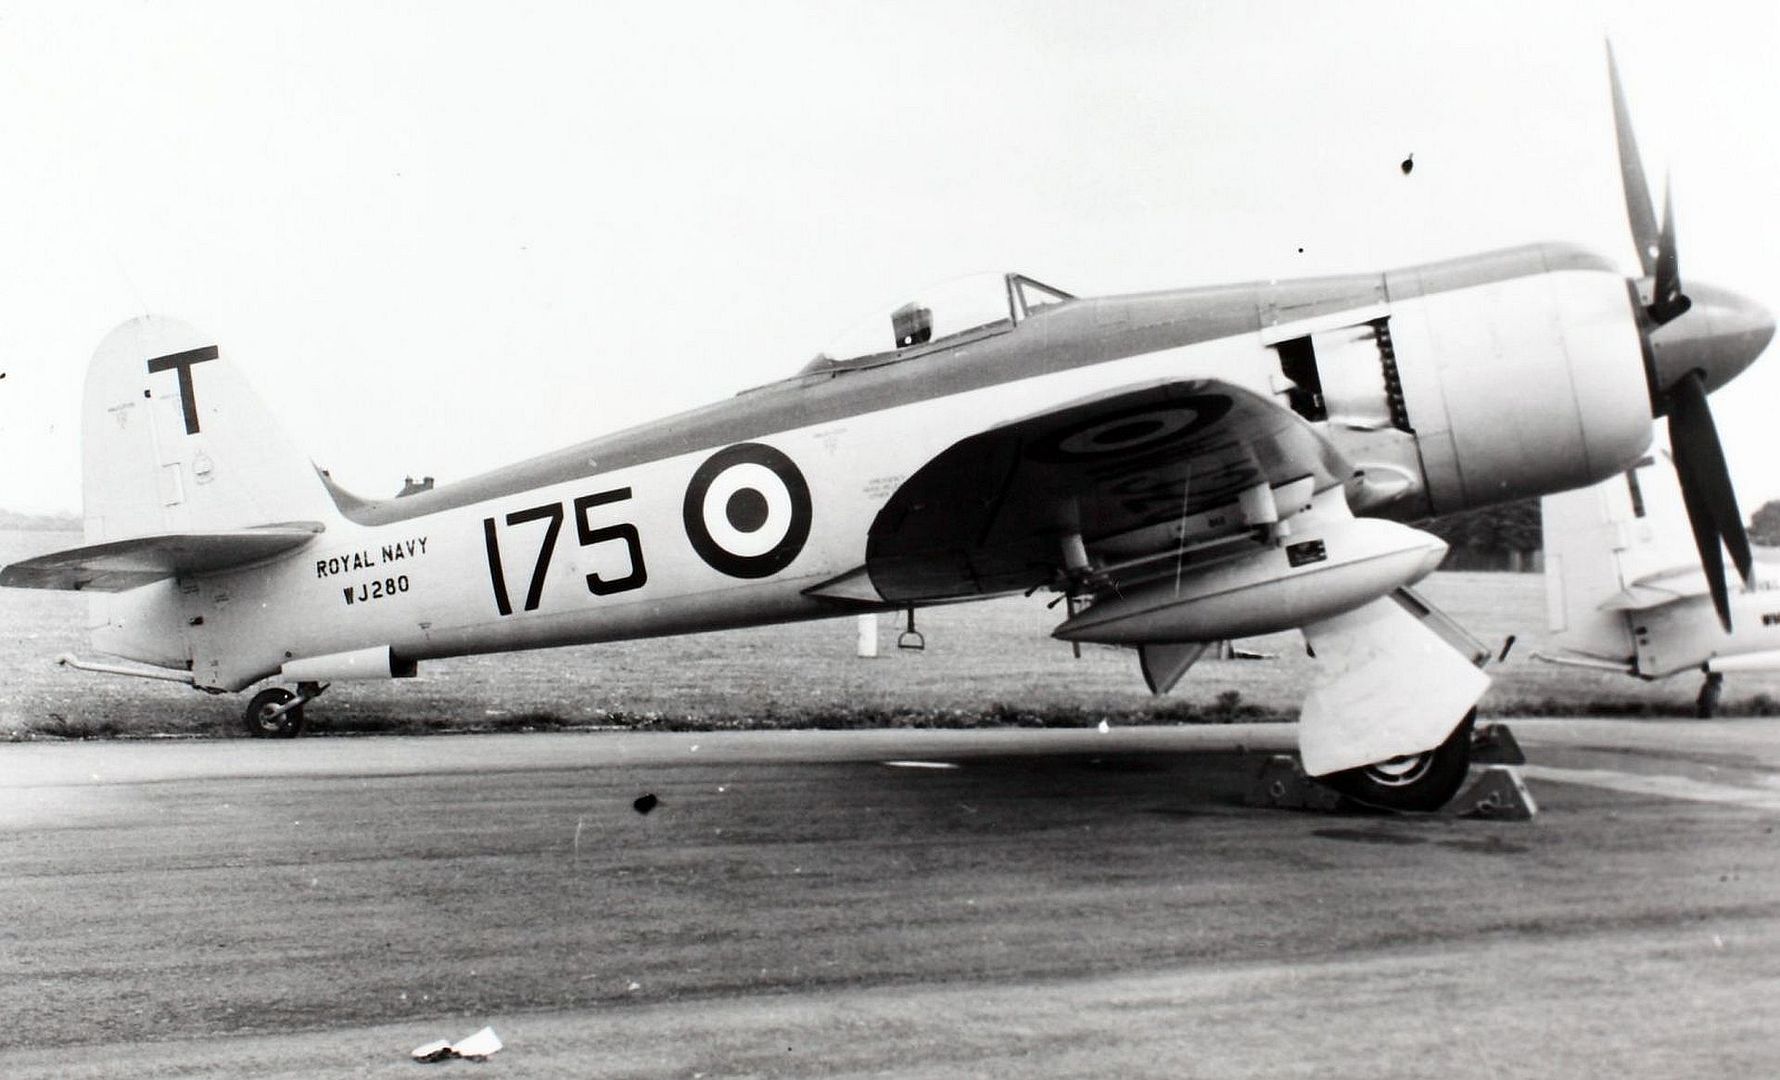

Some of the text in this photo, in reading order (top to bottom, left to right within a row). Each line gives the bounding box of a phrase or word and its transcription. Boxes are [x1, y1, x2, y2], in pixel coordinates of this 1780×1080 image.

[147, 345, 219, 435] T
[316, 537, 427, 579] ROYAL NAVY
[483, 486, 648, 617] 175
[343, 575, 409, 605] WJ280
